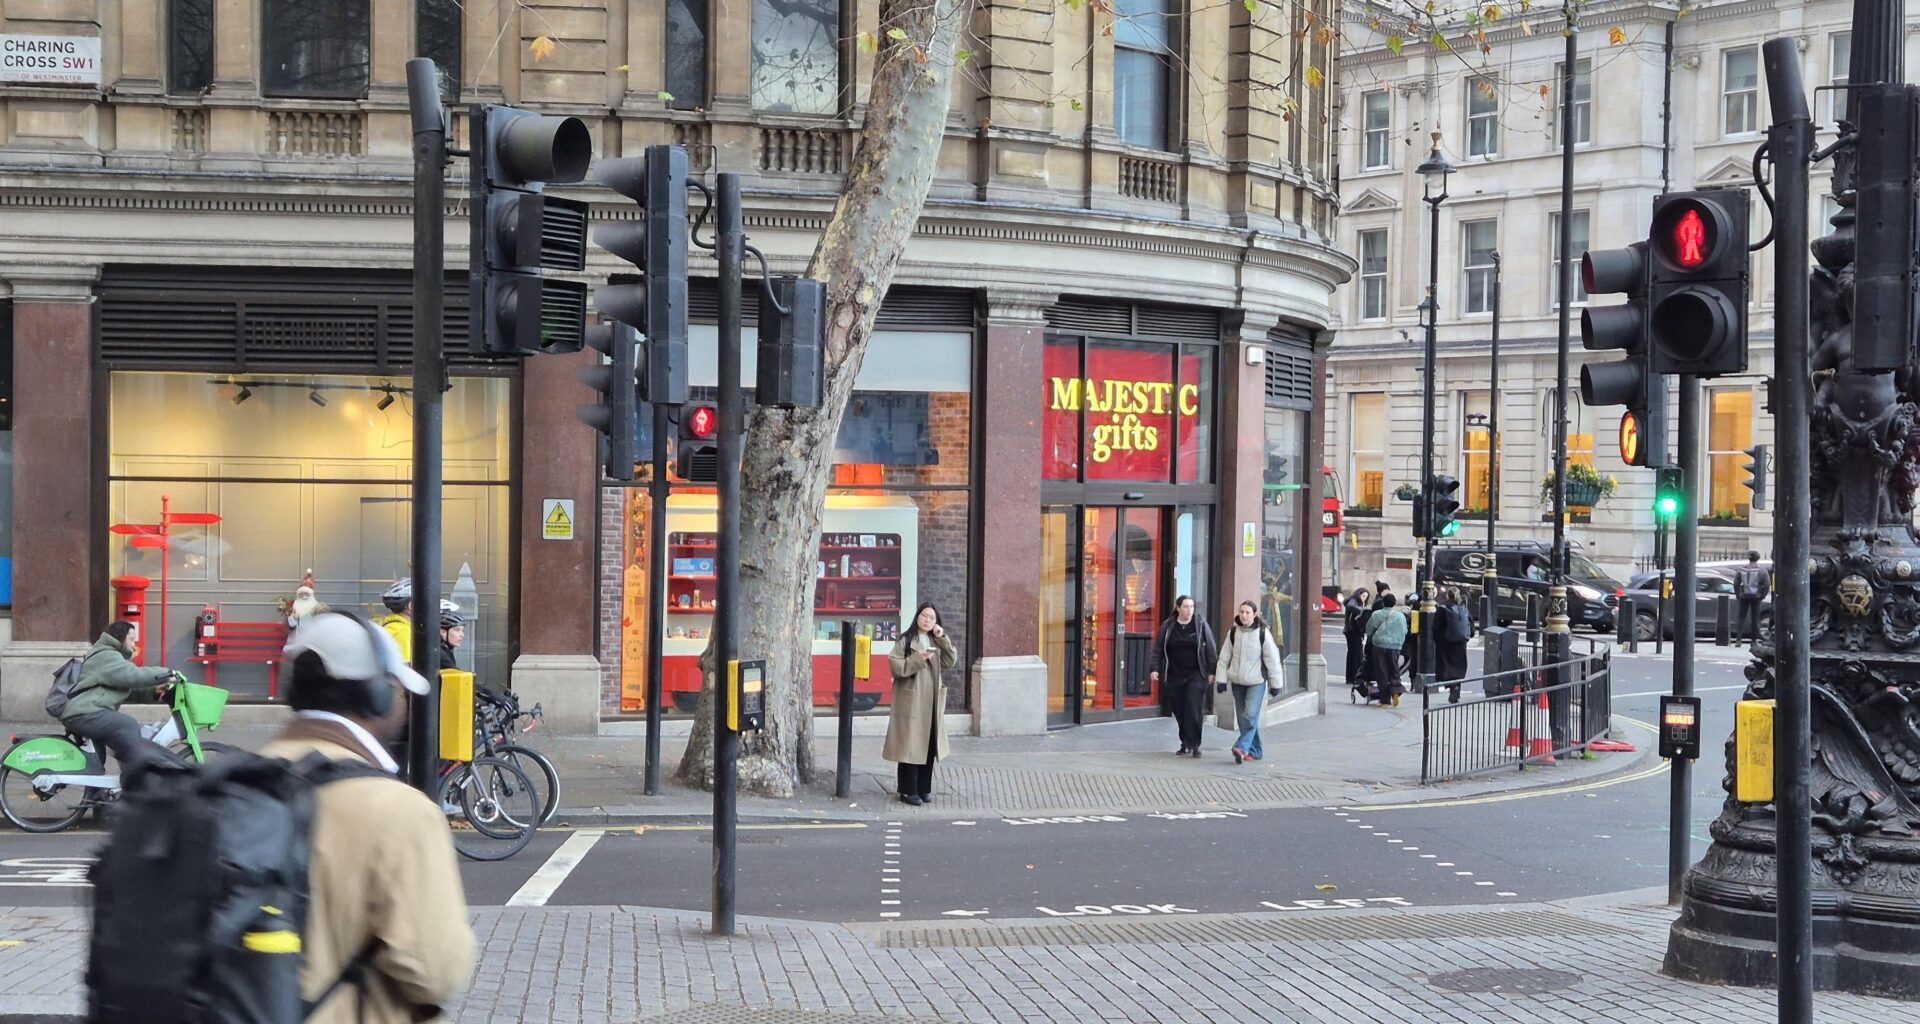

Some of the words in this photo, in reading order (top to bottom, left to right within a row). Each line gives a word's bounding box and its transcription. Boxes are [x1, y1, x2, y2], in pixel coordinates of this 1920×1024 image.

[4, 39, 75, 54] CHARING
[4, 54, 57, 68] CROSS
[1051, 376, 1198, 416] MAJESTC
[1092, 413, 1158, 463] gifts
[1666, 714, 1694, 725] WAIT
[1036, 903, 1198, 917] LOOK
[1259, 896, 1414, 911] LEFT
